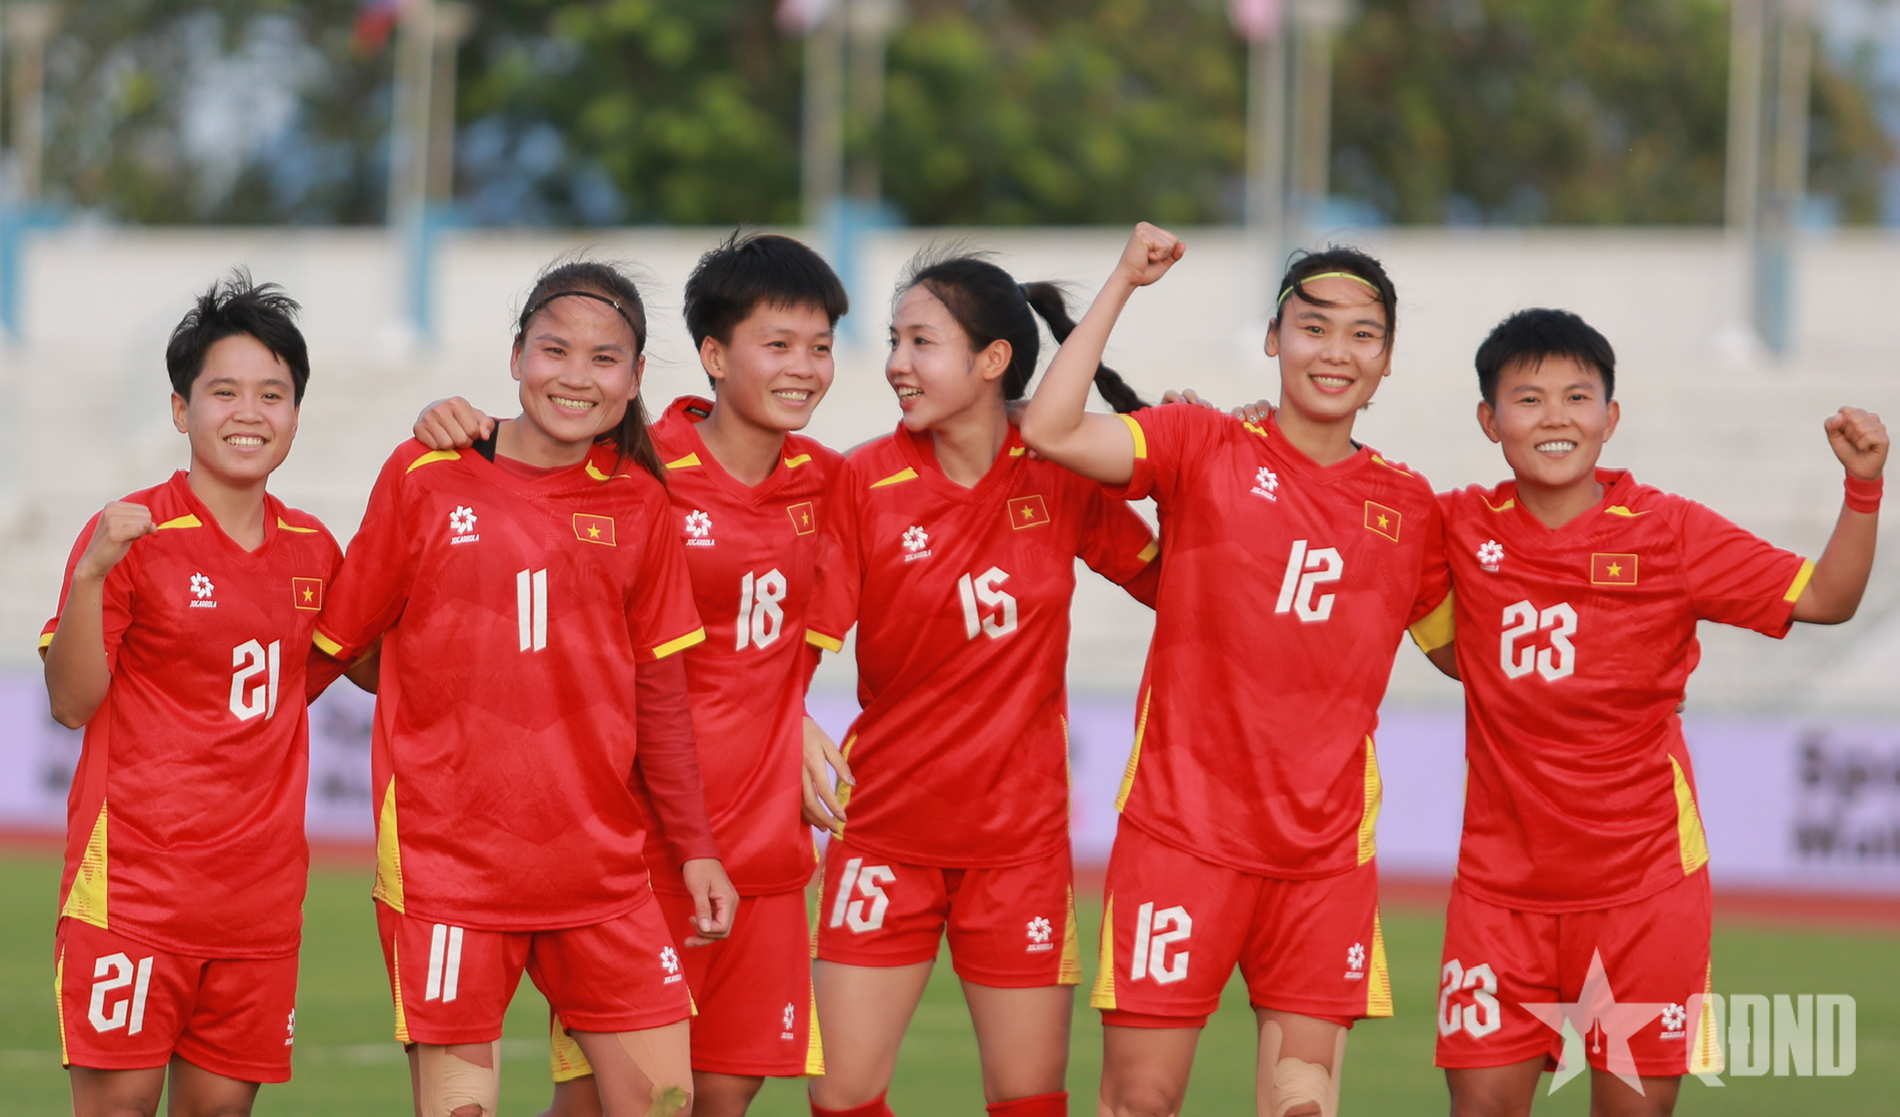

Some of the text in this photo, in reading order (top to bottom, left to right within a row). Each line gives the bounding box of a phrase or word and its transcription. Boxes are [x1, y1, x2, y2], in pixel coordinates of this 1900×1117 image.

[516, 568, 547, 652] 11
[735, 568, 787, 651] 18
[958, 566, 1017, 640] 15
[1275, 539, 1343, 622] 12
[229, 638, 280, 721] 21
[1500, 599, 1577, 681] 23
[830, 858, 897, 933] 15
[425, 924, 464, 1003] 11
[1131, 902, 1192, 985] 12
[88, 952, 154, 1036] 21
[1438, 958, 1501, 1038] 23
